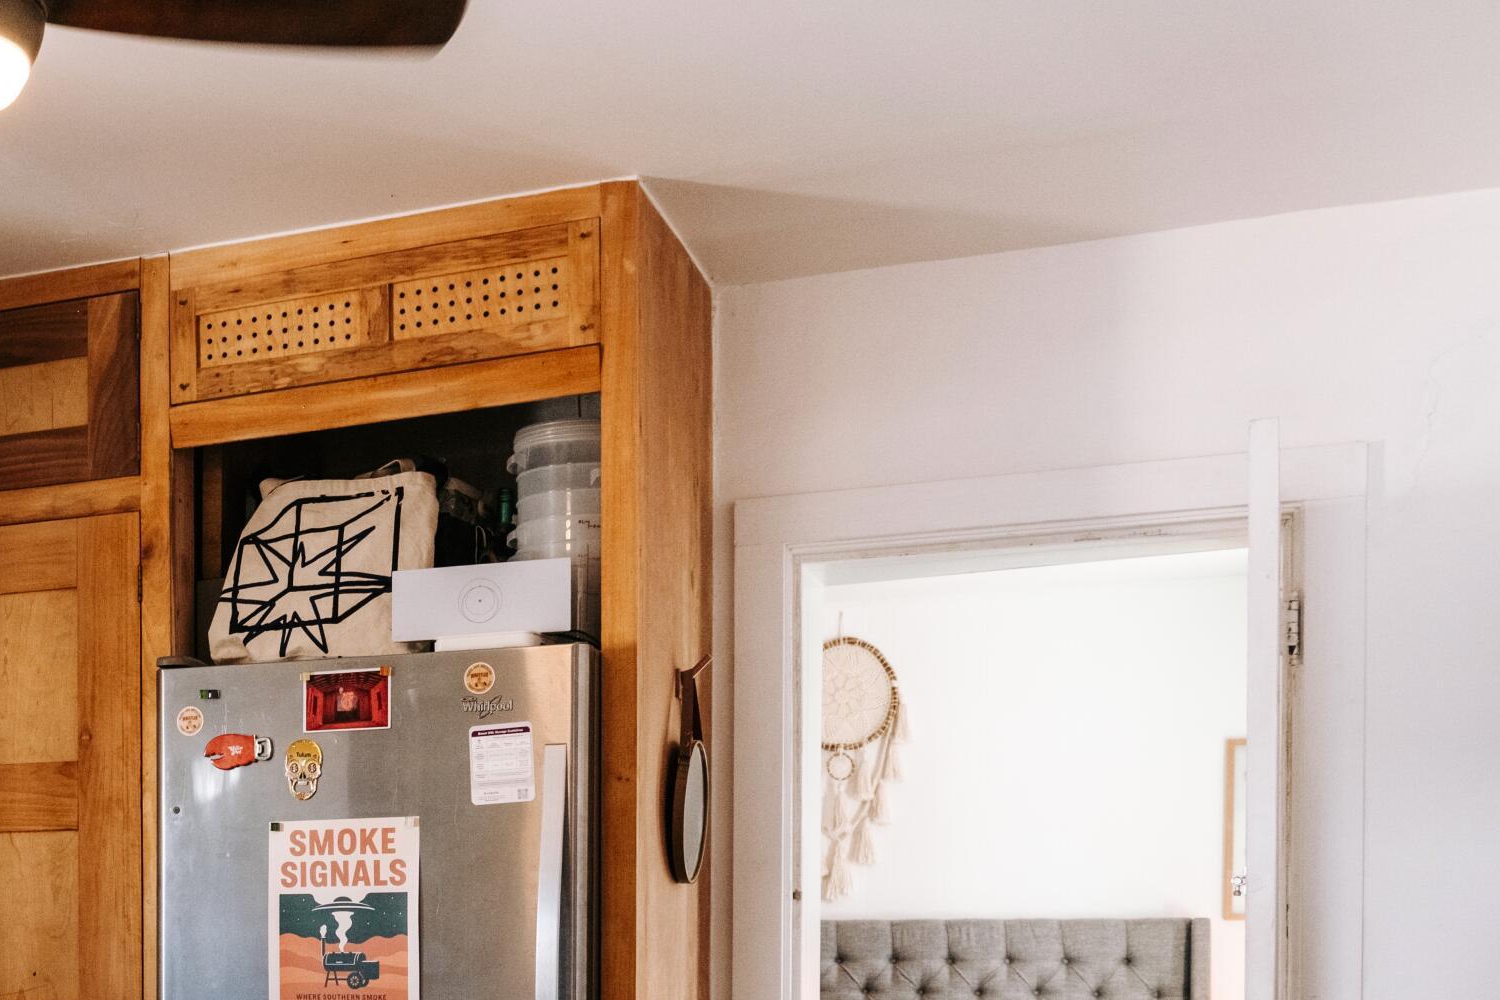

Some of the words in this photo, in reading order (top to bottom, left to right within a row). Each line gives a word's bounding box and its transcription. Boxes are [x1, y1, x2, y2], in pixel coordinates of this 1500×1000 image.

[462, 697, 514, 718] Whirlpool
[289, 827, 396, 857] SMOKE
[280, 859, 407, 888] SIGNALS
[296, 993, 321, 1000] WHERE
[323, 993, 360, 1000] SOUTHERN
